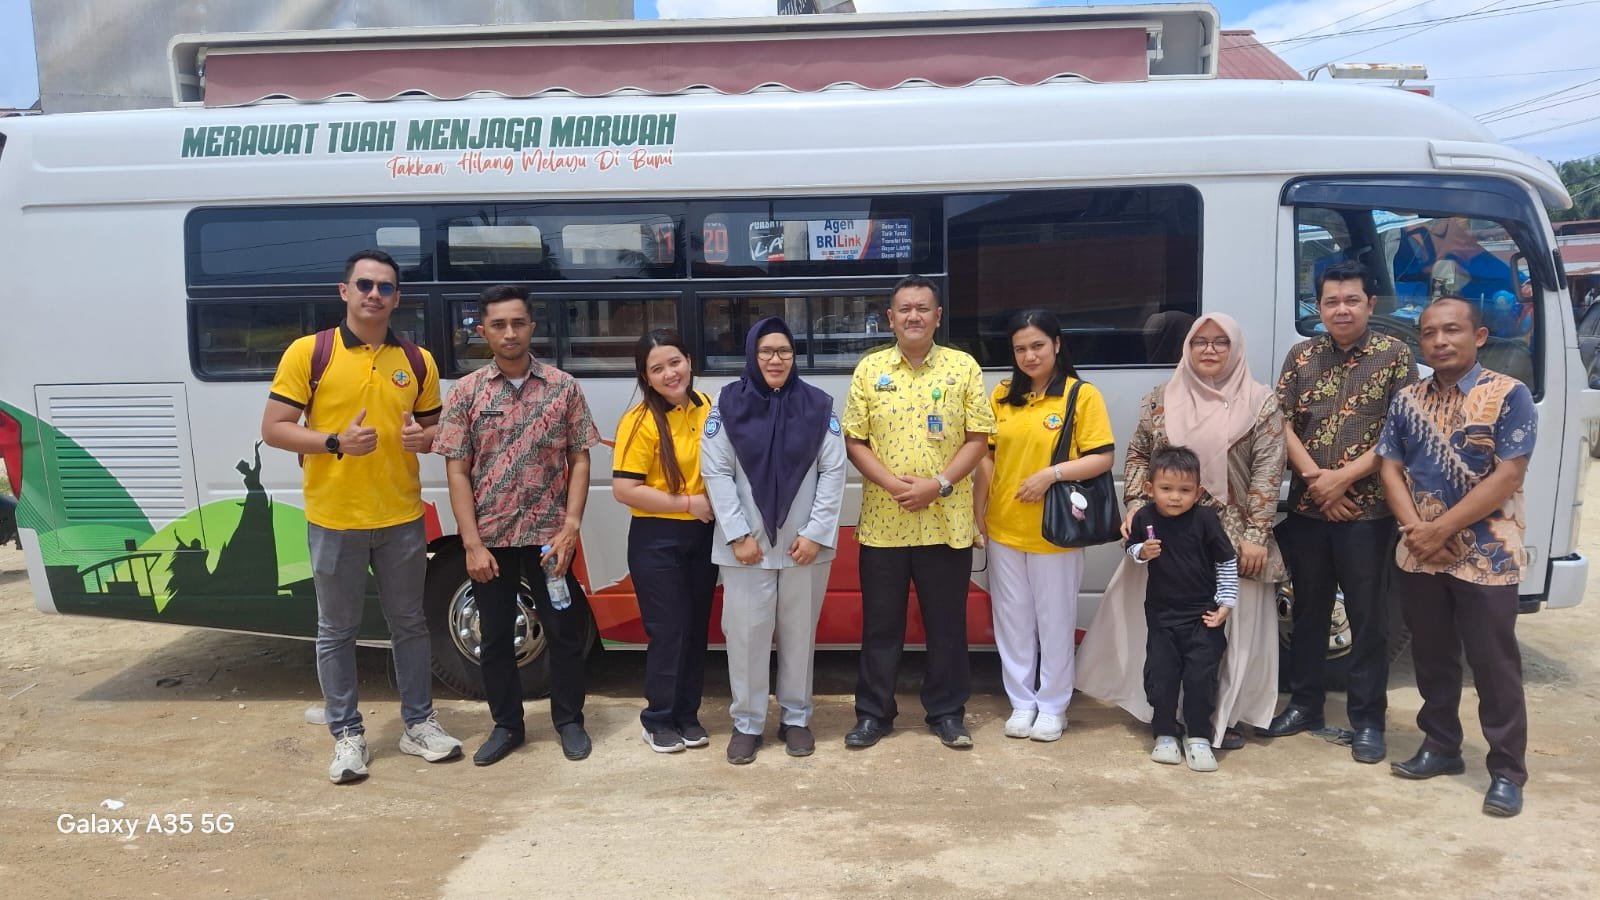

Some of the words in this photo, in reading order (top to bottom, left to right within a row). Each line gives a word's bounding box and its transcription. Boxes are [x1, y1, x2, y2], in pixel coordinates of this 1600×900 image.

[181, 123, 320, 158] MERAWAT
[328, 120, 397, 153] TUAH
[406, 117, 543, 152] MENJAGA
[550, 114, 677, 148] MARWAH
[386, 155, 447, 178] Takkan
[457, 150, 513, 175] Hilang
[521, 149, 586, 174] Melayu
[593, 149, 619, 170] Di
[628, 149, 673, 170] Bumi
[824, 219, 854, 233] Agen
[816, 235, 861, 248] BRILink
